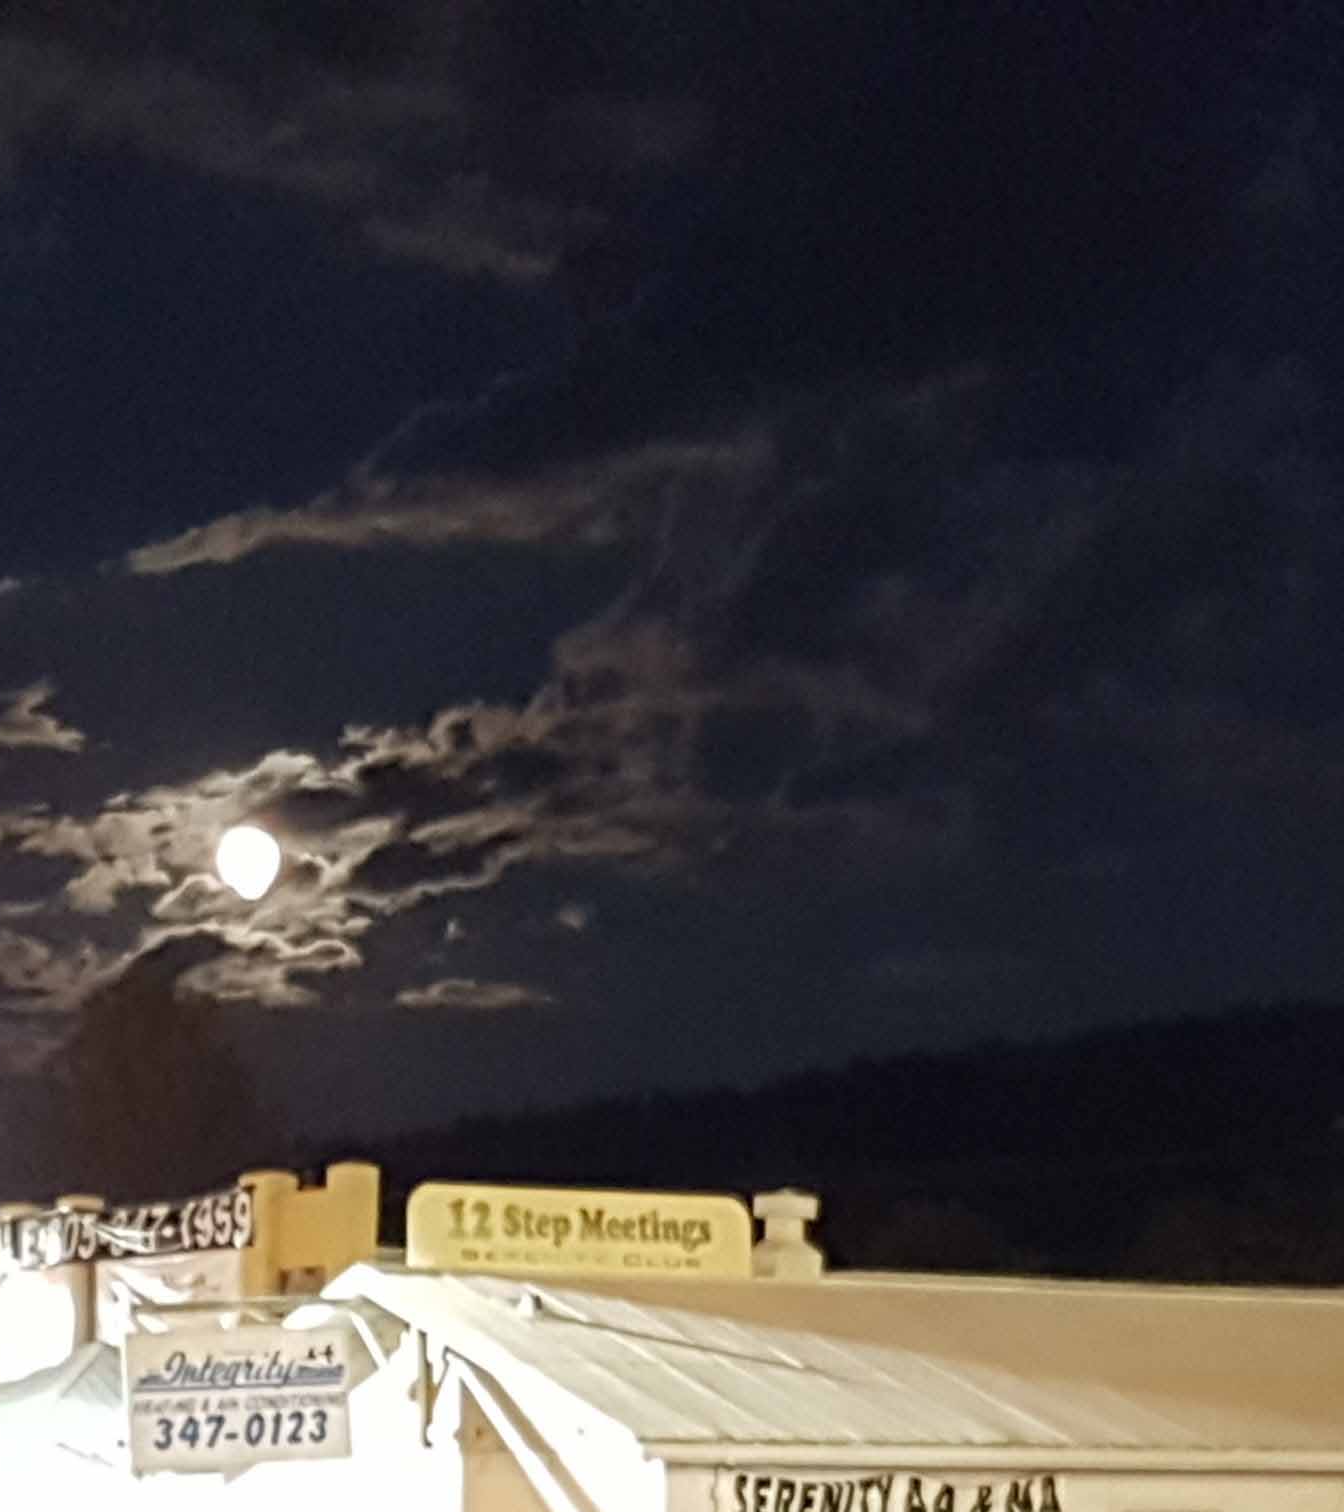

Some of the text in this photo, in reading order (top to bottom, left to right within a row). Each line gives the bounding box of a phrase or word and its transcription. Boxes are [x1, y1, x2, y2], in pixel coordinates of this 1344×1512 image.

[447, 1198, 712, 1251] 12 Step Meetings
[164, 1350, 294, 1389] Integrity
[153, 1409, 329, 1451] 347-0123
